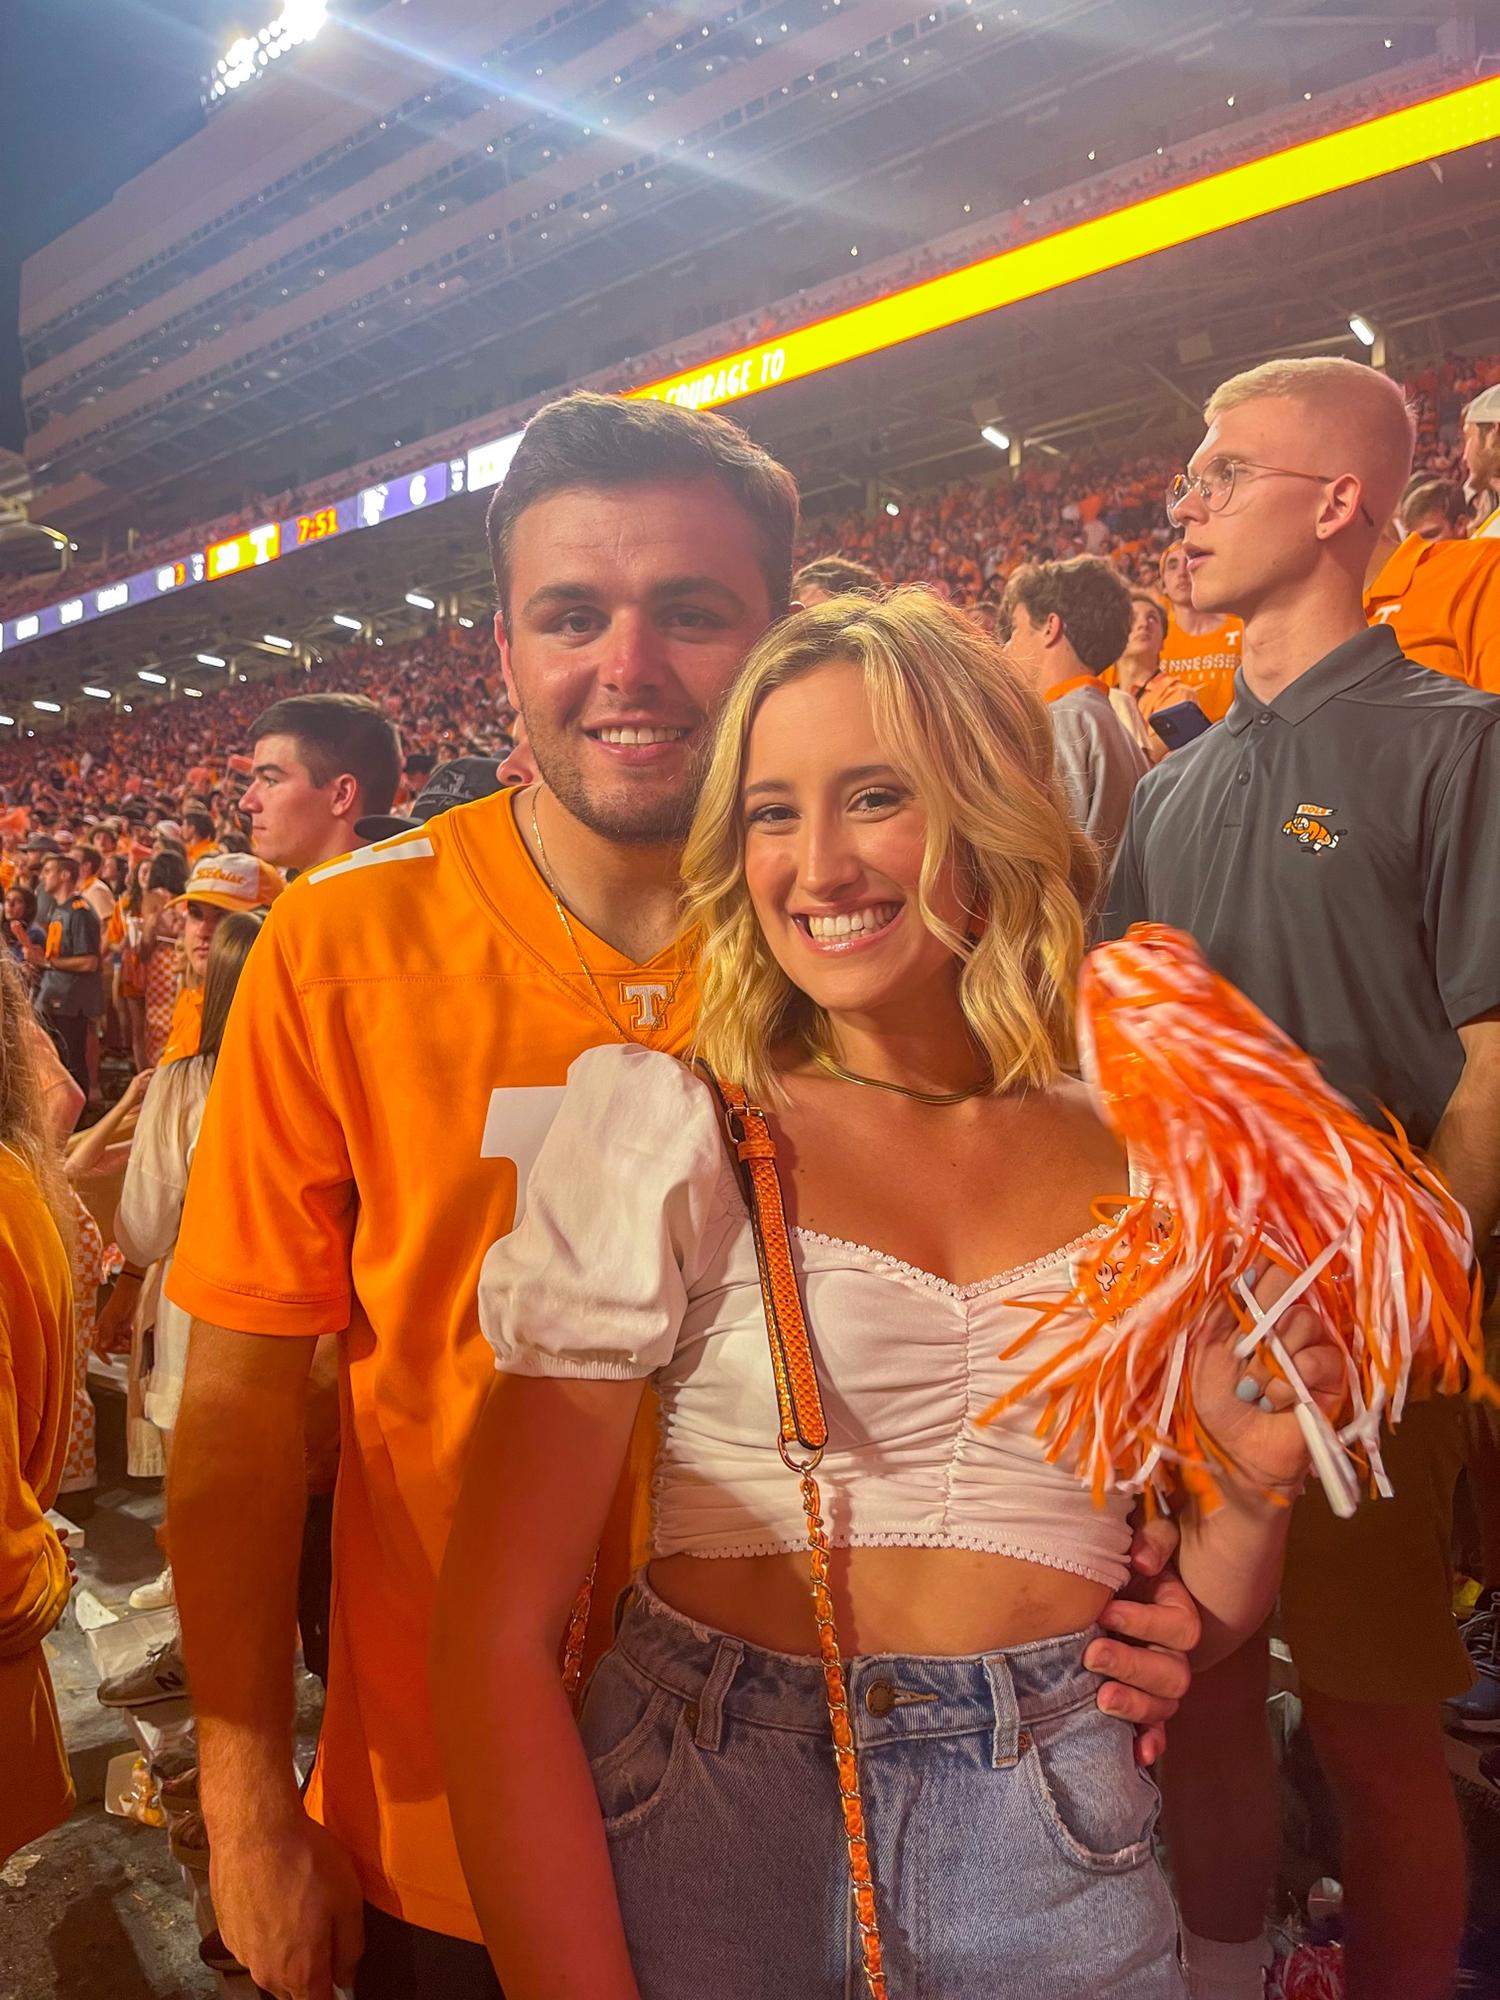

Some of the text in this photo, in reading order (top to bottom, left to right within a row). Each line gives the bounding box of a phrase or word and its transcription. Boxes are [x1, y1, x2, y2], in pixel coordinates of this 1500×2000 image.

[761, 348, 785, 384] TO
[296, 507, 338, 545] 7:51
[1225, 629, 1240, 647] T
[1159, 653, 1241, 673] ENNESSE
[621, 983, 672, 1030] T
